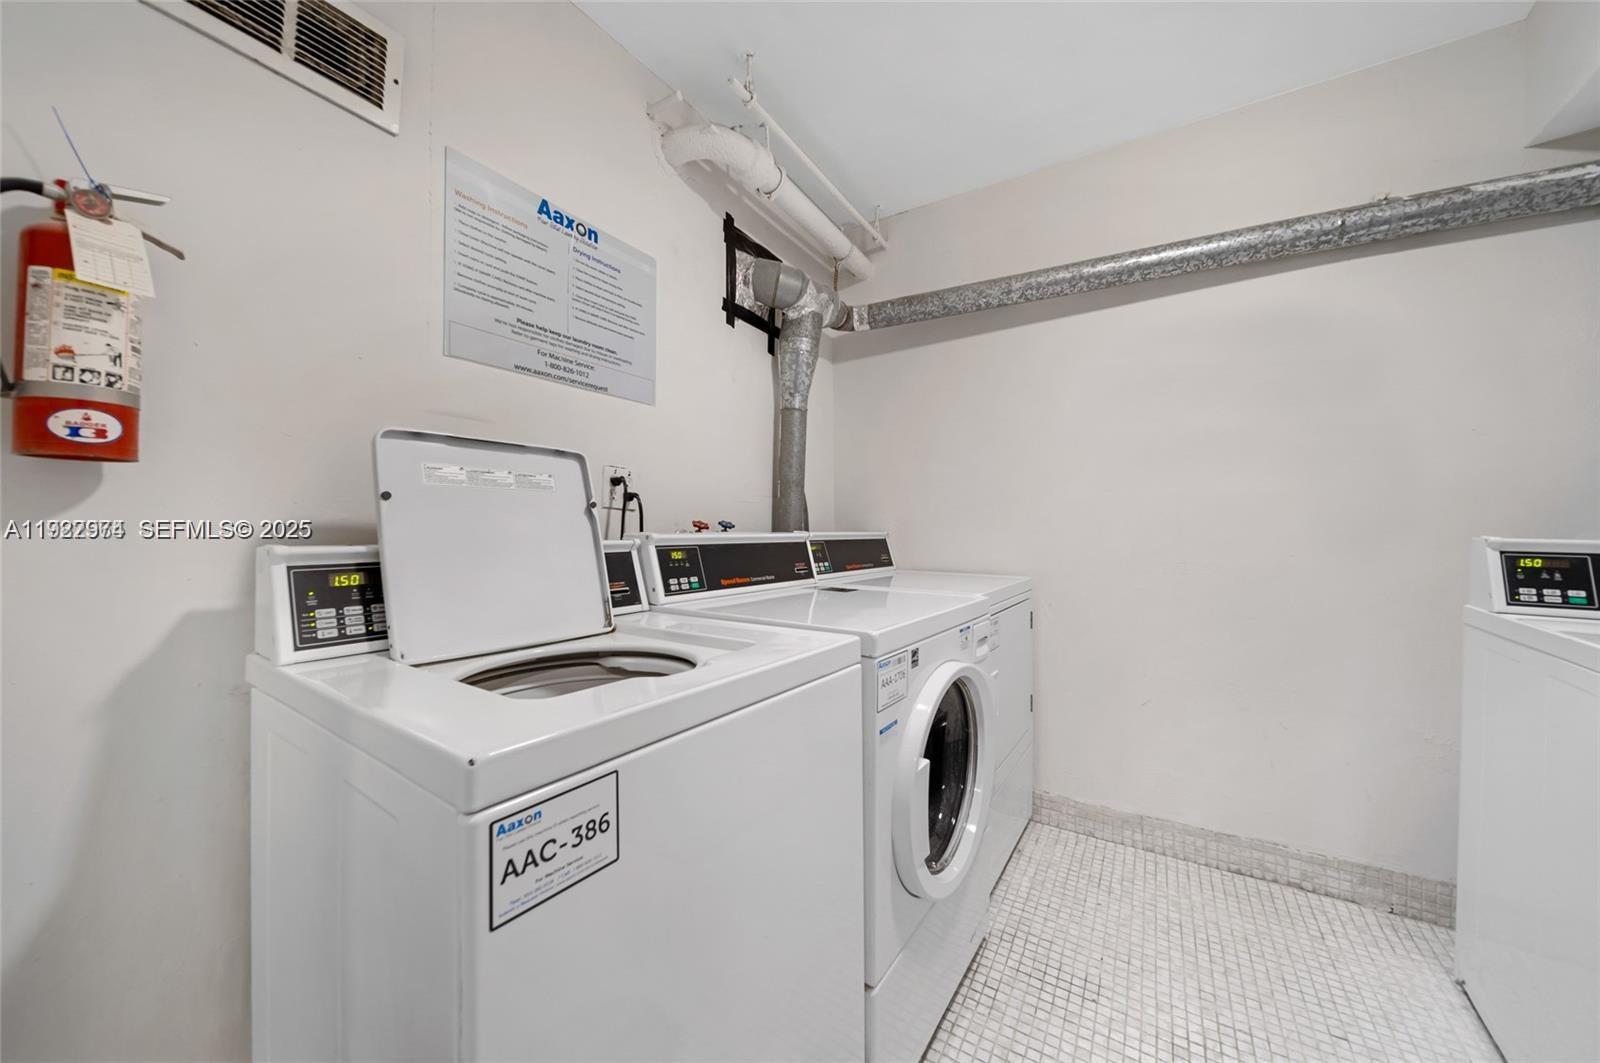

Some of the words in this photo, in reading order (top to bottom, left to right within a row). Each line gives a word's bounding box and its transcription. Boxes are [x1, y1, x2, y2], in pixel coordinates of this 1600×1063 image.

[537, 198, 598, 245] Aaxon
[573, 246, 591, 261] Drying
[592, 256, 622, 274] Instructions
[516, 317, 535, 329] Please
[535, 322, 548, 334] help
[549, 327, 561, 338] keep
[536, 349, 547, 358] For
[548, 352, 574, 365] Machine
[496, 810, 542, 838] Aaxon
[499, 811, 610, 886] AAC-386
